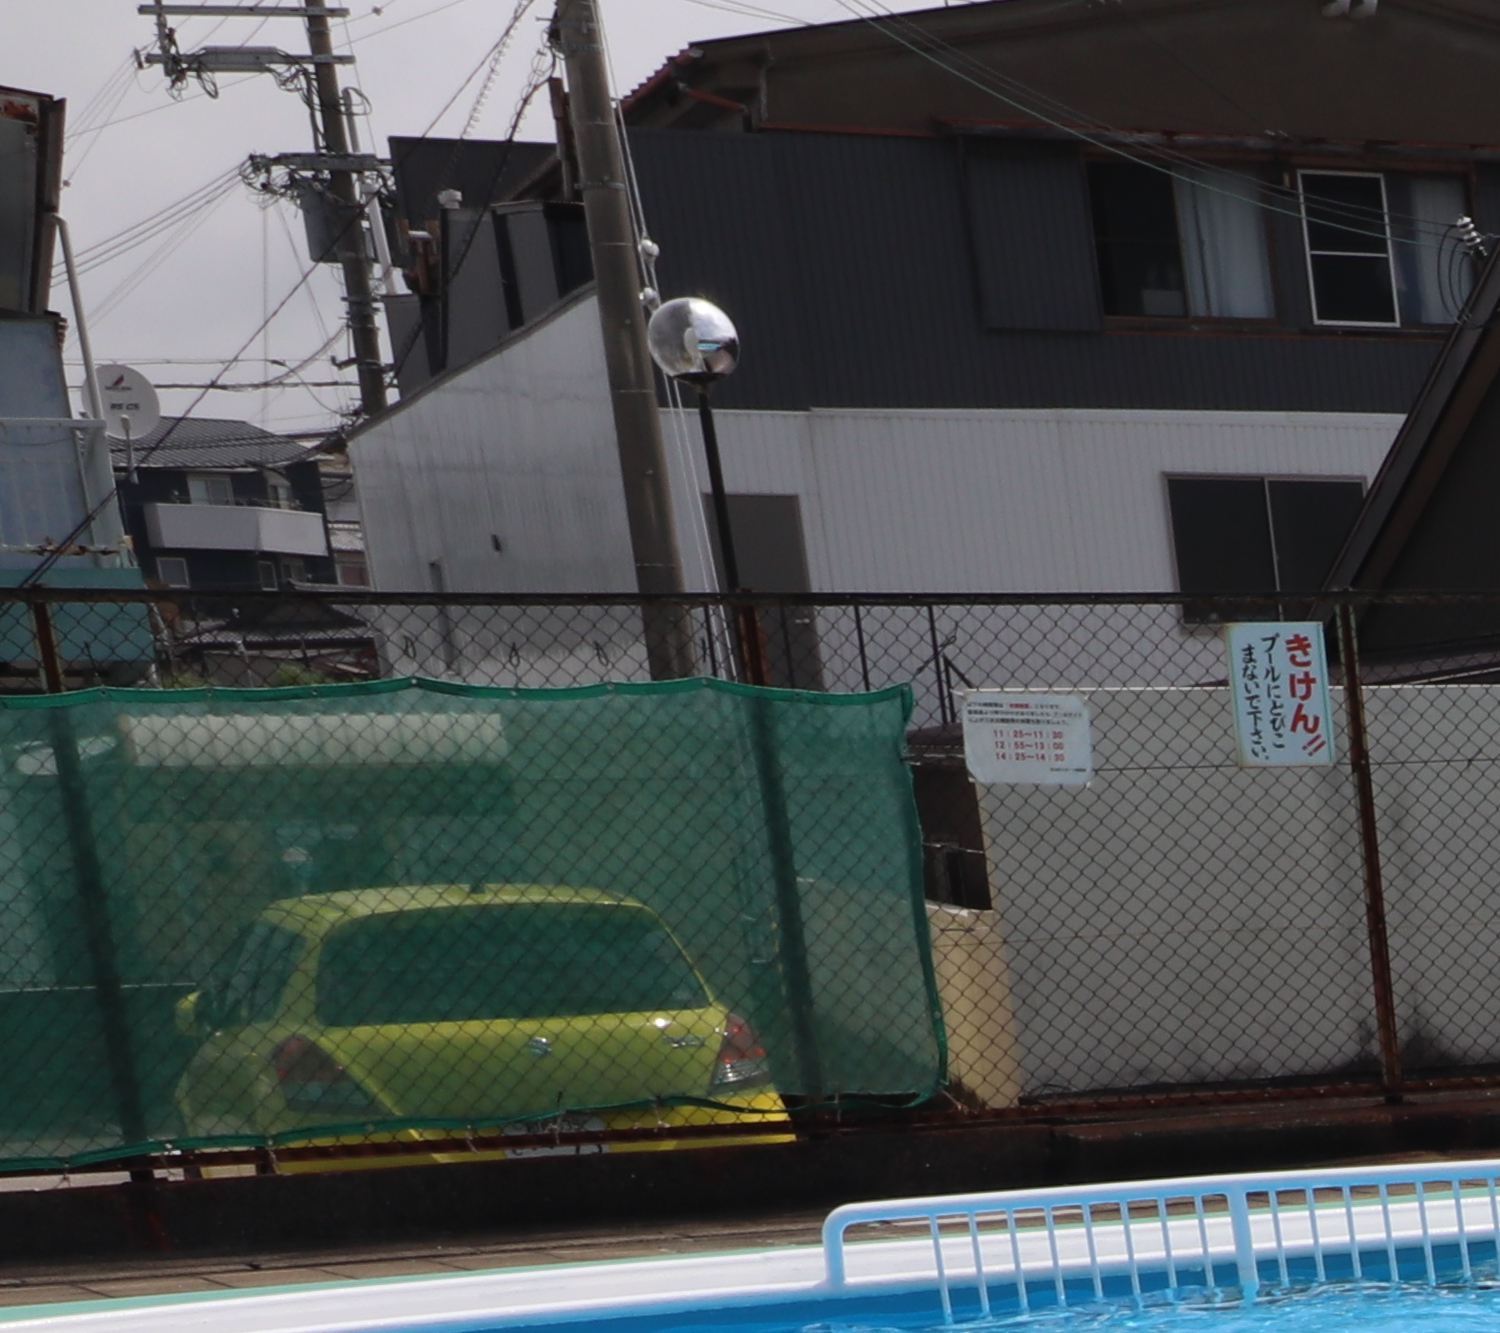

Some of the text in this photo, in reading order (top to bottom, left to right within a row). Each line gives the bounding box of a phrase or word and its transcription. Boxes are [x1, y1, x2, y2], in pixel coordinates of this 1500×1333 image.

[1261, 632, 1286, 749] プールにとびこ
[1285, 633, 1327, 757] きけん!!
